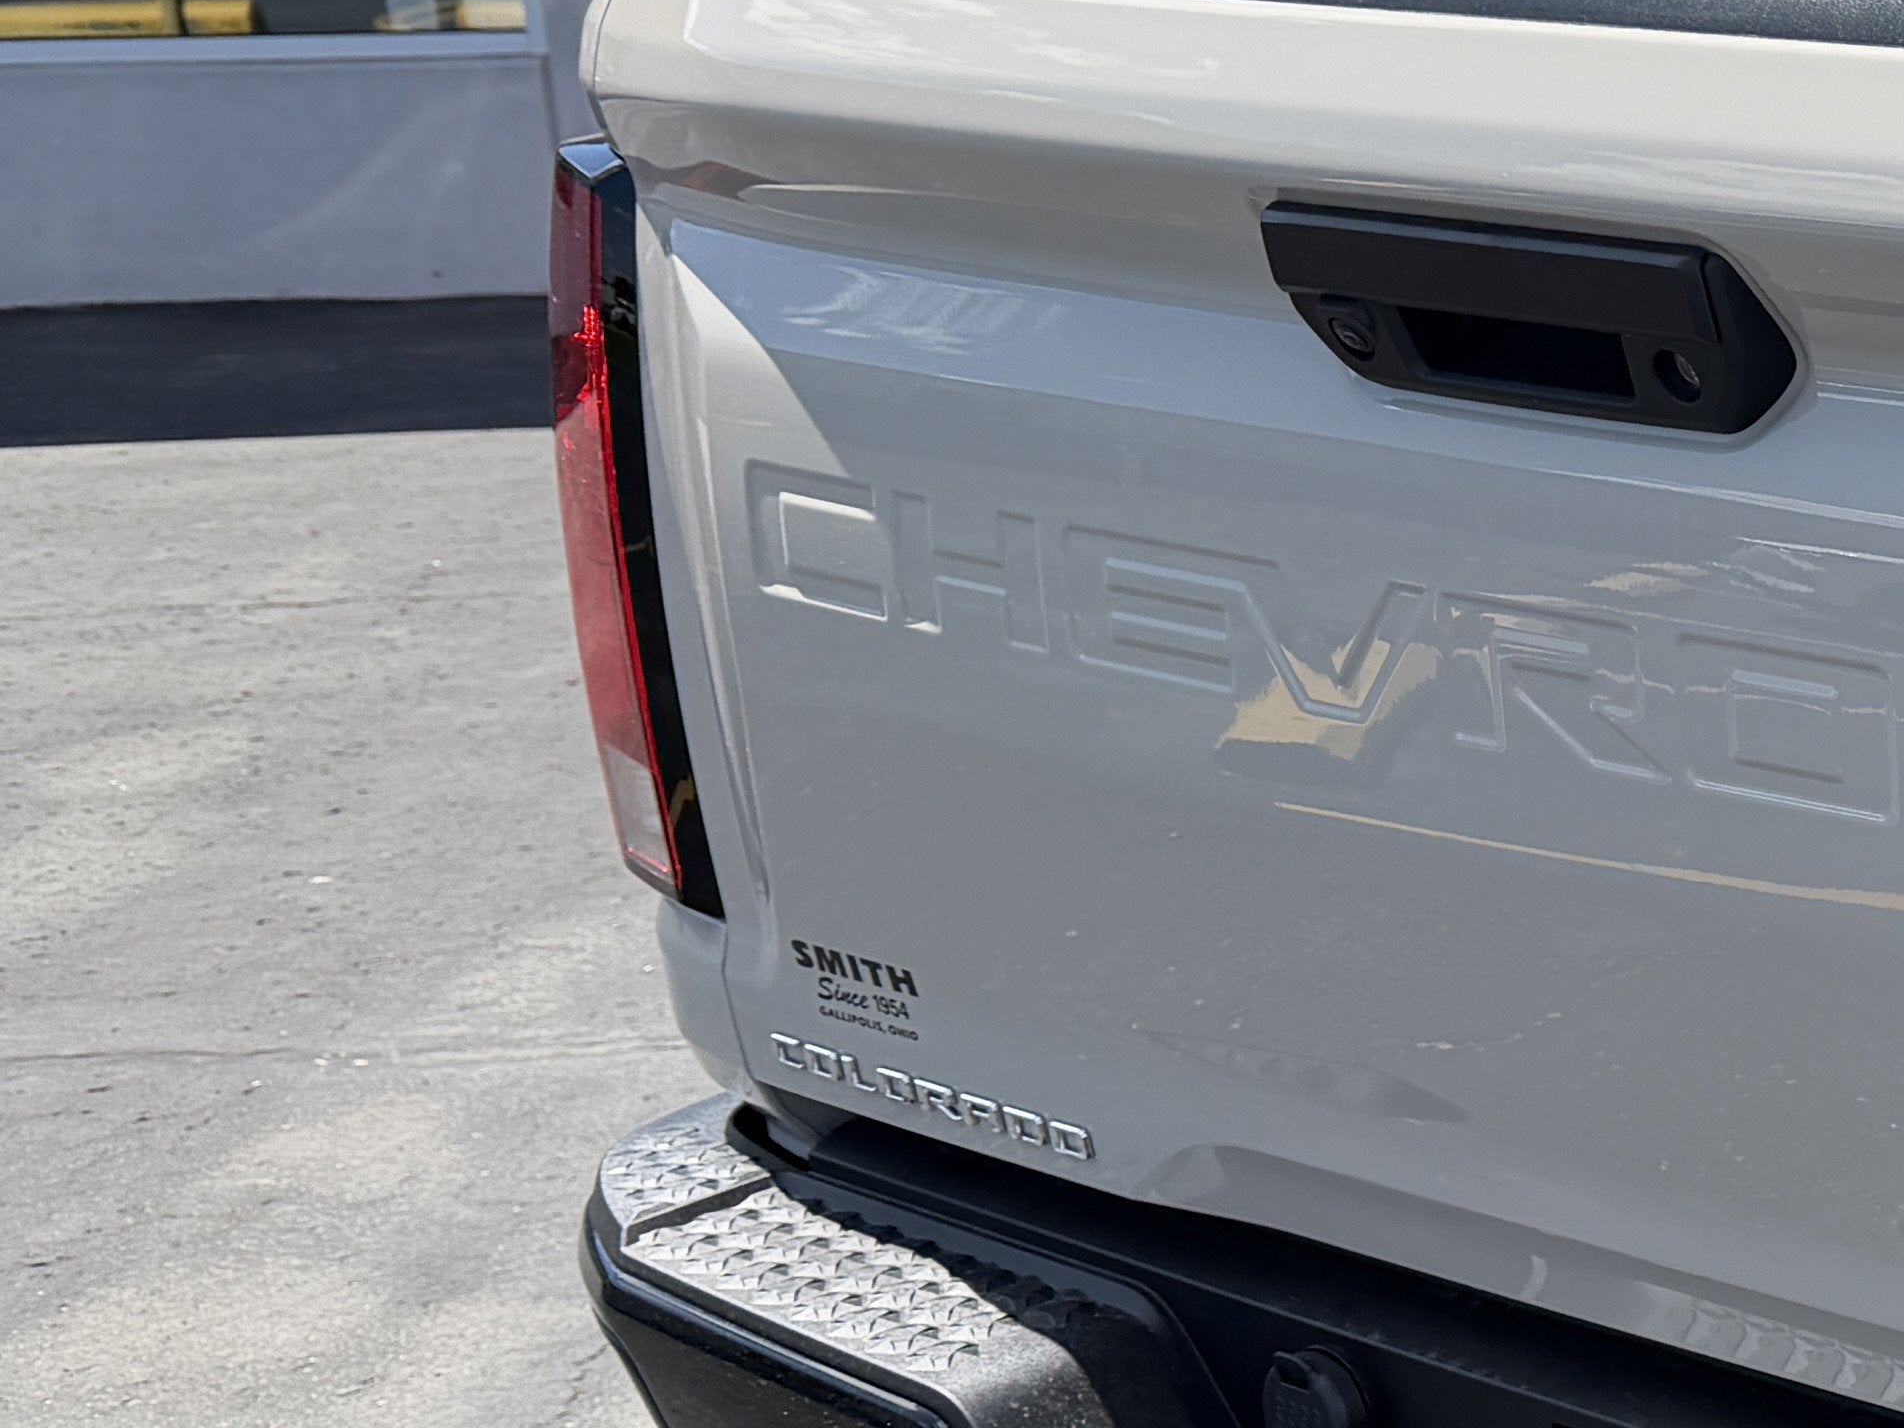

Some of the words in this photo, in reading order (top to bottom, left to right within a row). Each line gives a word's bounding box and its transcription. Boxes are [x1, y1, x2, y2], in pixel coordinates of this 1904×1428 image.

[791, 939, 919, 998] SMITH
[817, 976, 870, 1009] Since
[872, 994, 910, 1020] 1954
[887, 1024, 919, 1042] OHIO
[770, 1032, 1096, 1161] COLORADO
